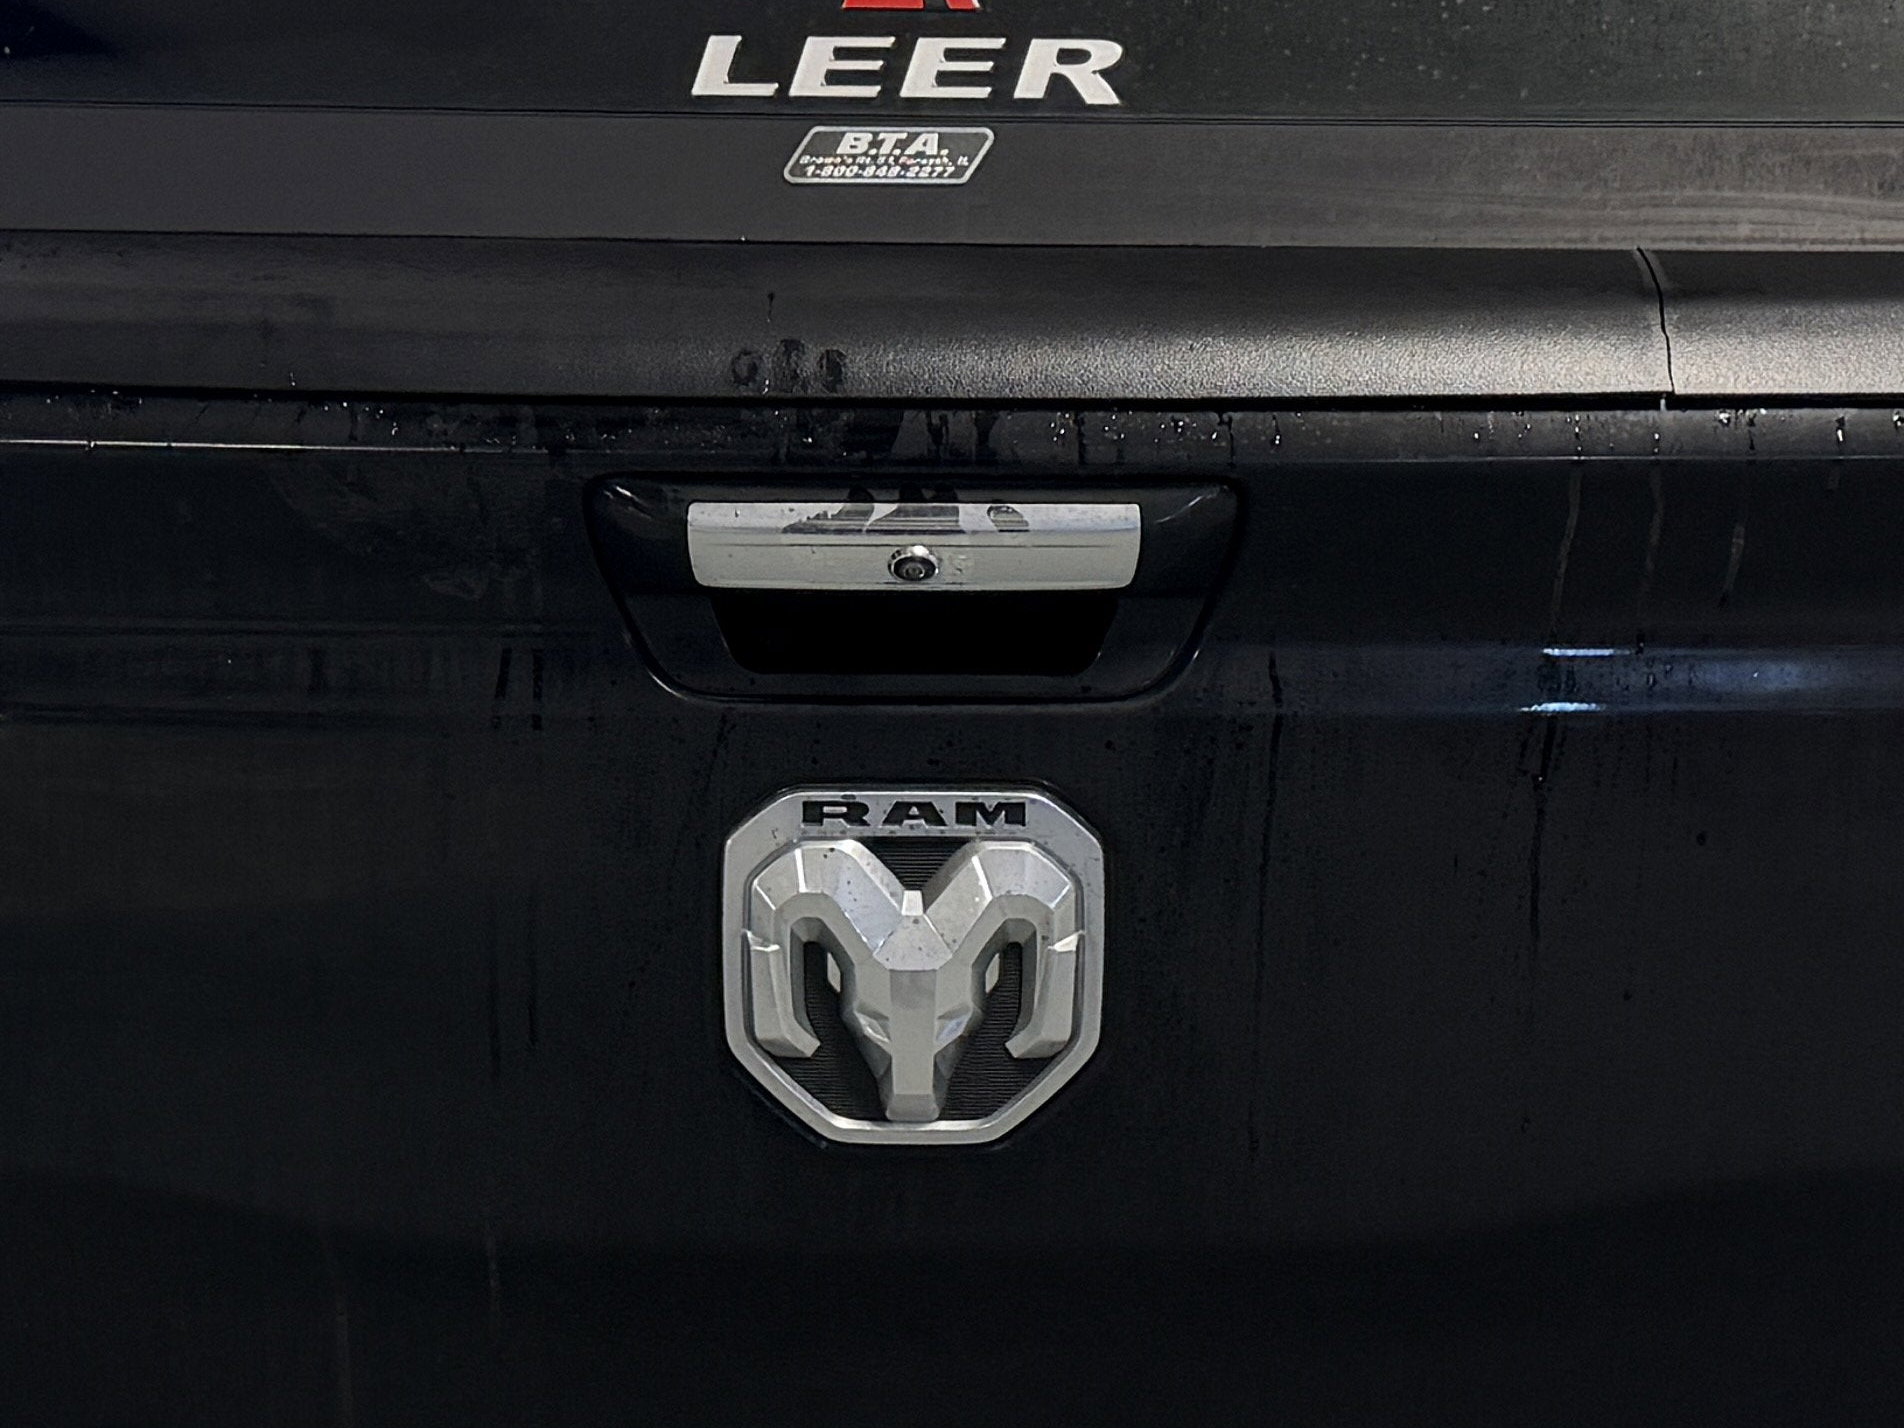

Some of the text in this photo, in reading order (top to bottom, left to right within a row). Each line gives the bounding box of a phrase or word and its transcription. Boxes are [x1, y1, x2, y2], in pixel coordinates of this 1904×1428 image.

[691, 35, 1124, 105] LEER
[836, 132, 949, 156] B.T.A.
[801, 800, 1027, 828] RAM
